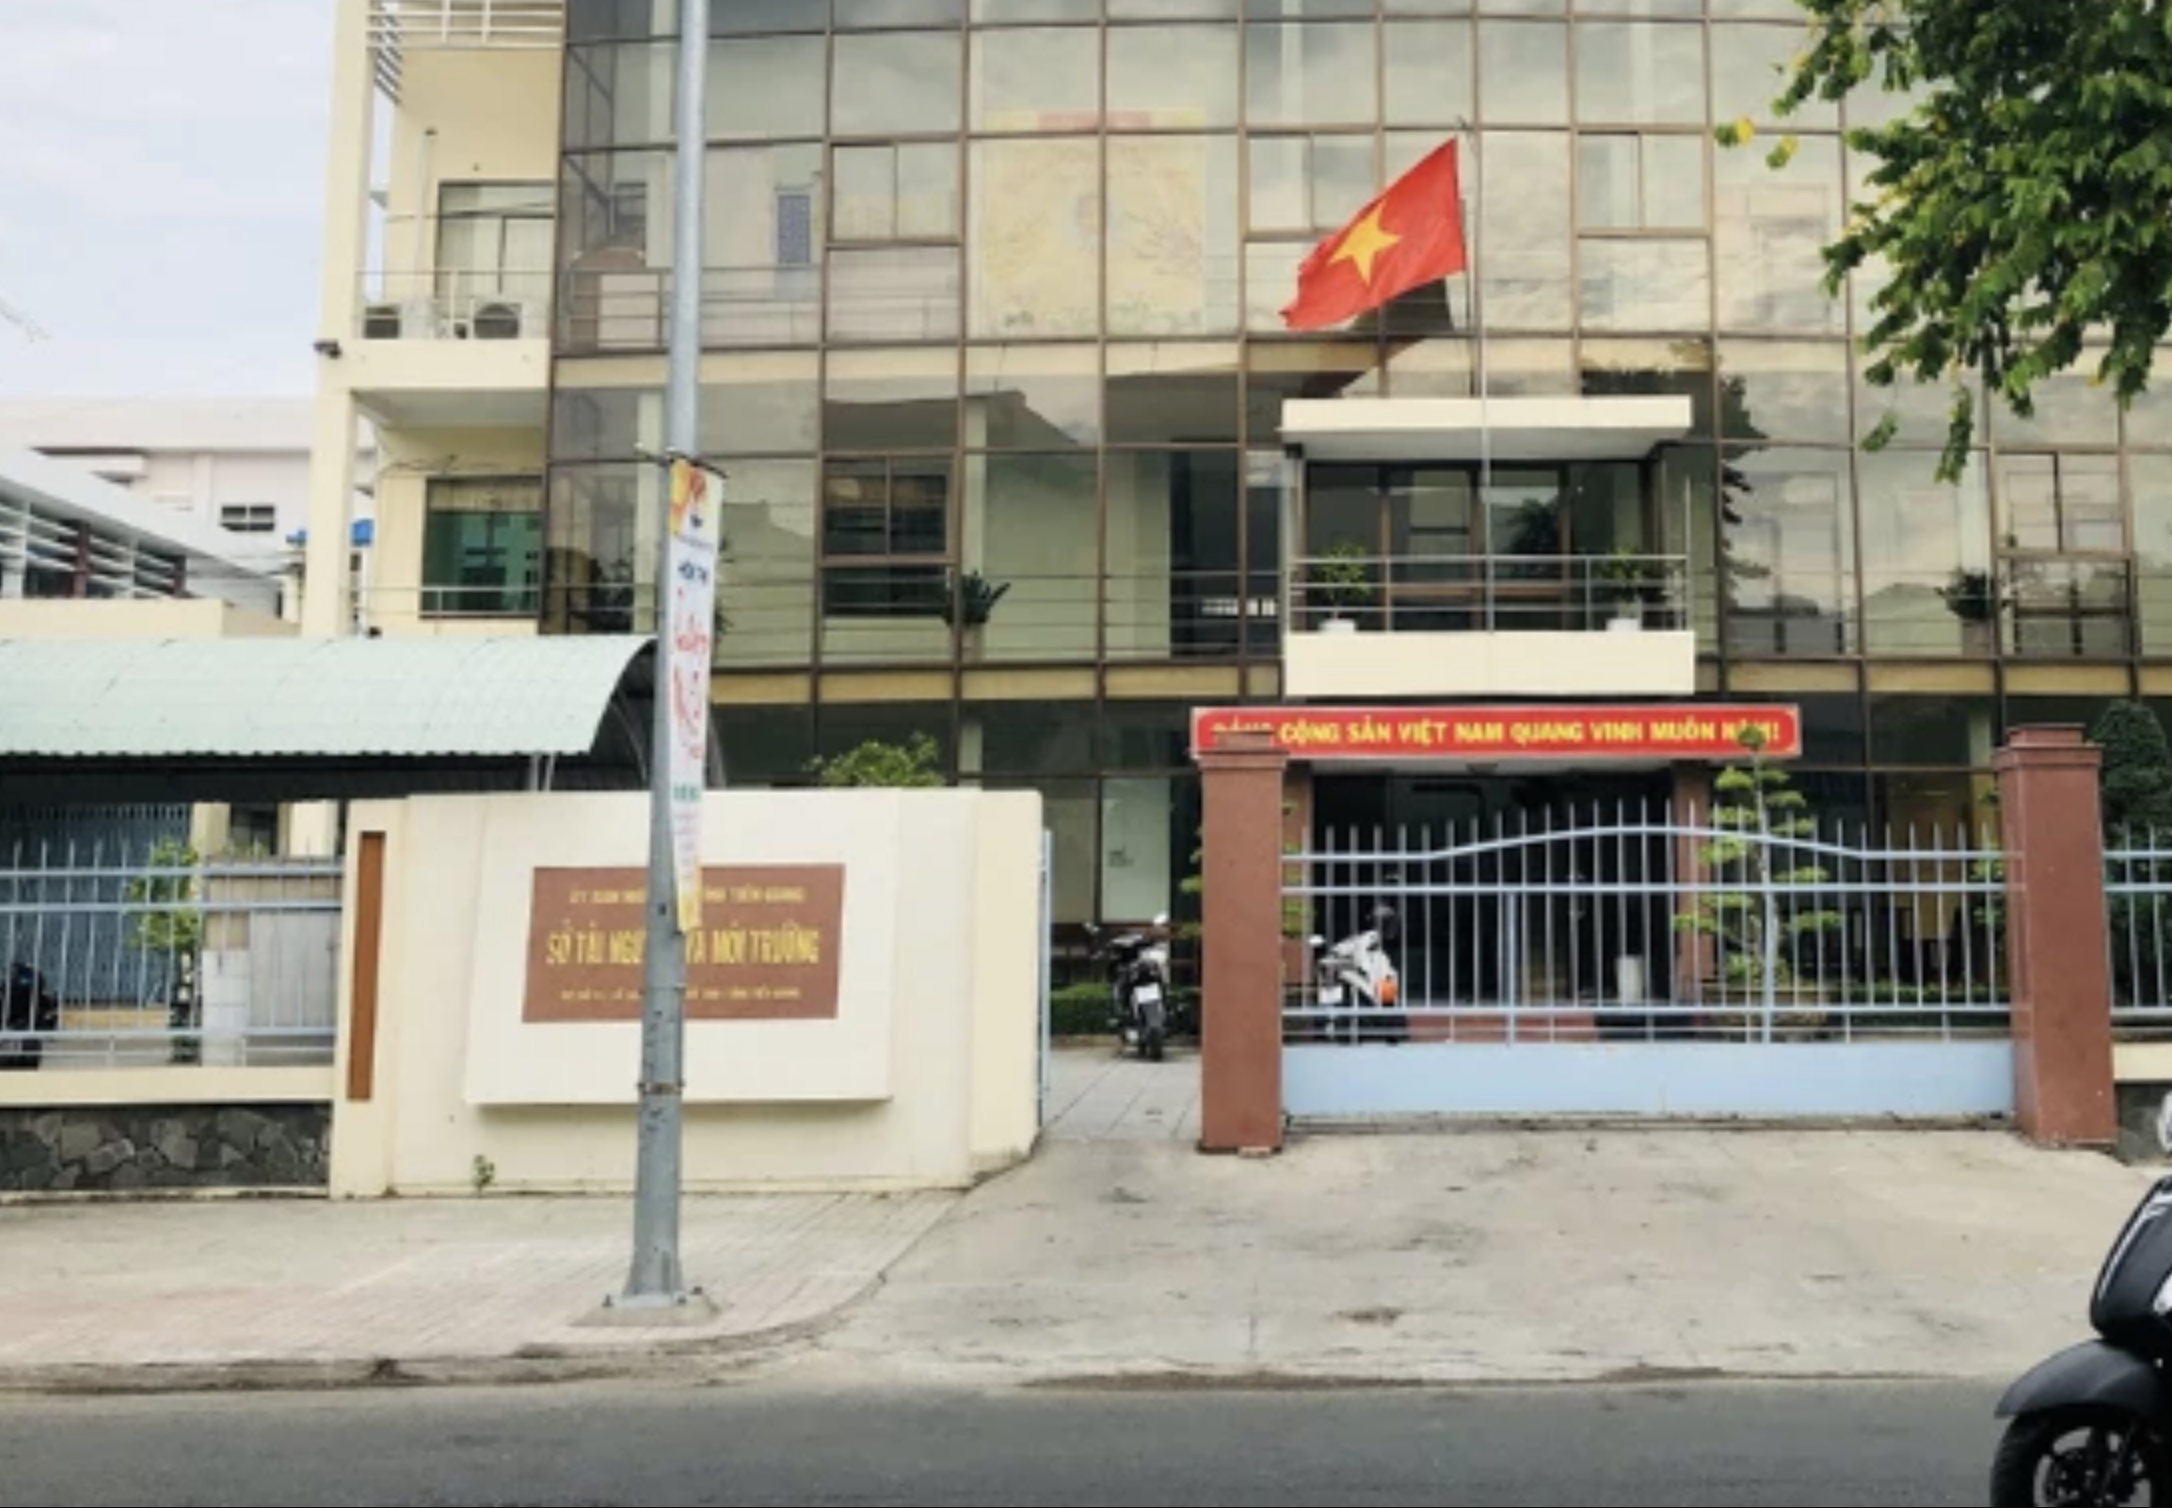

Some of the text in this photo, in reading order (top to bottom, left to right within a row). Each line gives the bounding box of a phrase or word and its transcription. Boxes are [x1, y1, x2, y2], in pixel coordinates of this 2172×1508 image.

[1279, 717, 1340, 746] CỘNG
[1346, 714, 1392, 744] SẢN
[1397, 719, 1448, 747] VIỆT
[1454, 721, 1504, 744] NAM
[1510, 721, 1584, 747] QUANG
[1589, 721, 1643, 742] VINH
[1650, 715, 1716, 742] MUÔN
[546, 918, 571, 964] SỞ
[576, 919, 604, 964] TÀI
[712, 920, 747, 964] MÔI
[749, 919, 820, 964] TRƯỜNG
